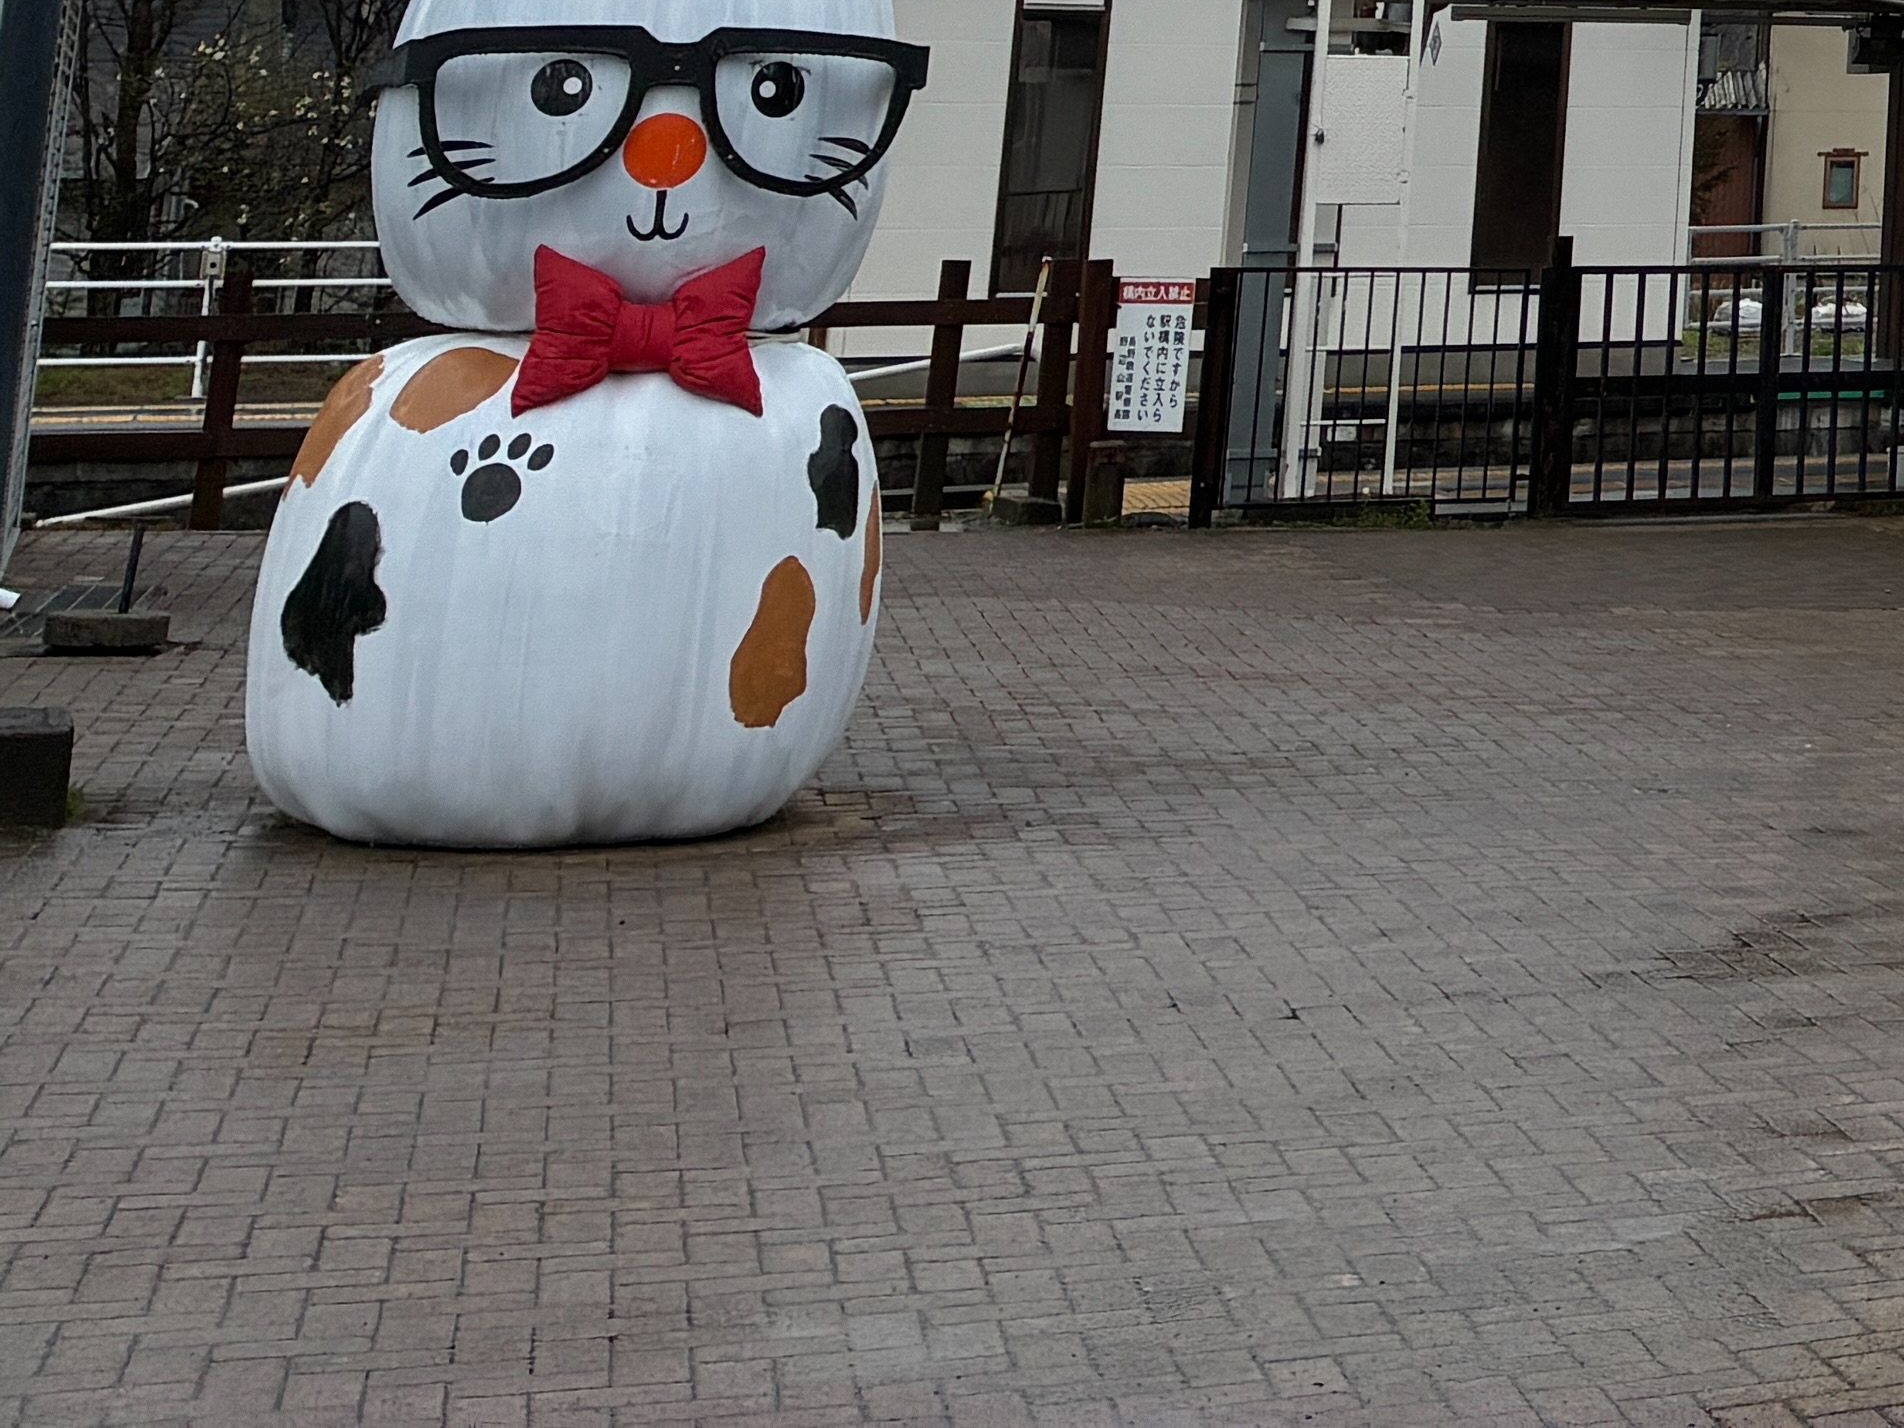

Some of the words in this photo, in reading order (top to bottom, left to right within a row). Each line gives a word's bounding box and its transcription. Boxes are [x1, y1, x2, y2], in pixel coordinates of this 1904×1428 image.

[1137, 314, 1156, 421] ないでください
[1153, 314, 1172, 422] 駅構内に立入ら
[1169, 315, 1187, 408] 危険ですから
